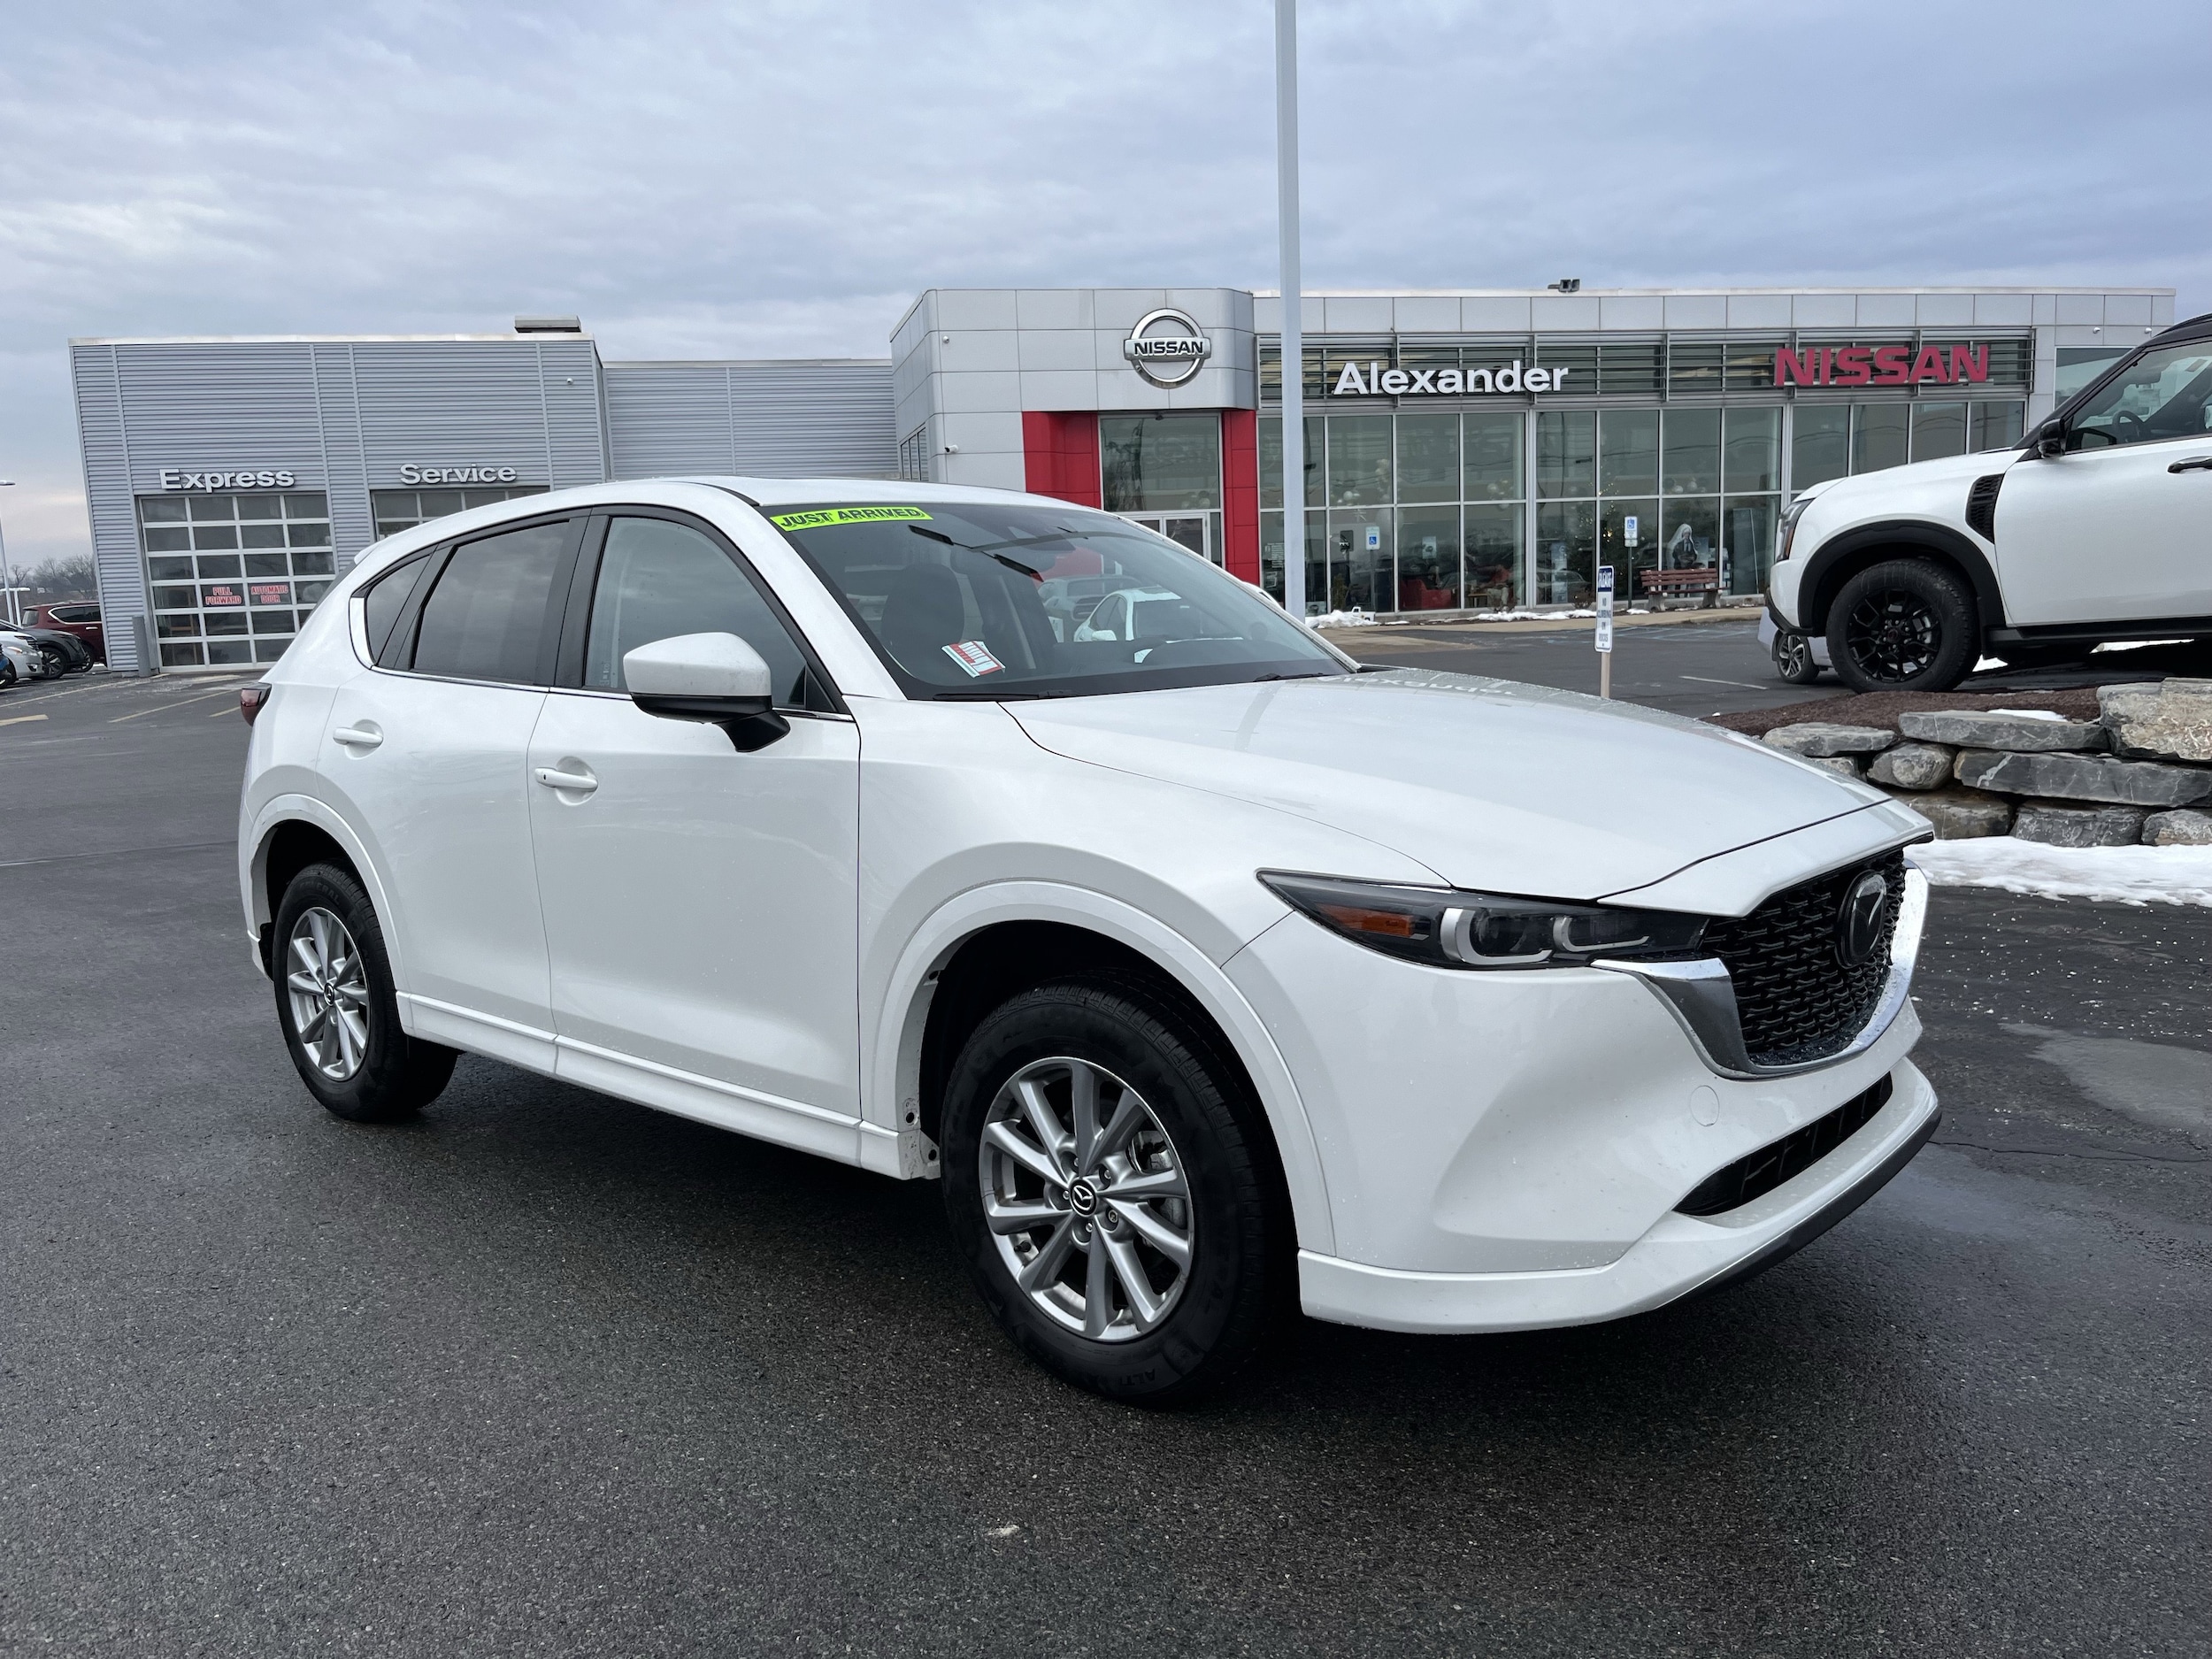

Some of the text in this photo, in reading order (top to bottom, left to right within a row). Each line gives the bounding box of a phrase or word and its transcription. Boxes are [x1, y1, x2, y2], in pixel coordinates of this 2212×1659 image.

[1134, 341, 1203, 355] NISSAN
[1774, 345, 1989, 387] NISSAN
[1333, 360, 1569, 396] Alexander
[159, 463, 517, 494] Express Service
[780, 508, 926, 527] JUST ARRIVED
[212, 587, 233, 595] PULL
[250, 585, 289, 595] AUTOMATIC
[205, 595, 242, 605] FORWARD
[260, 595, 281, 603] DOOR
